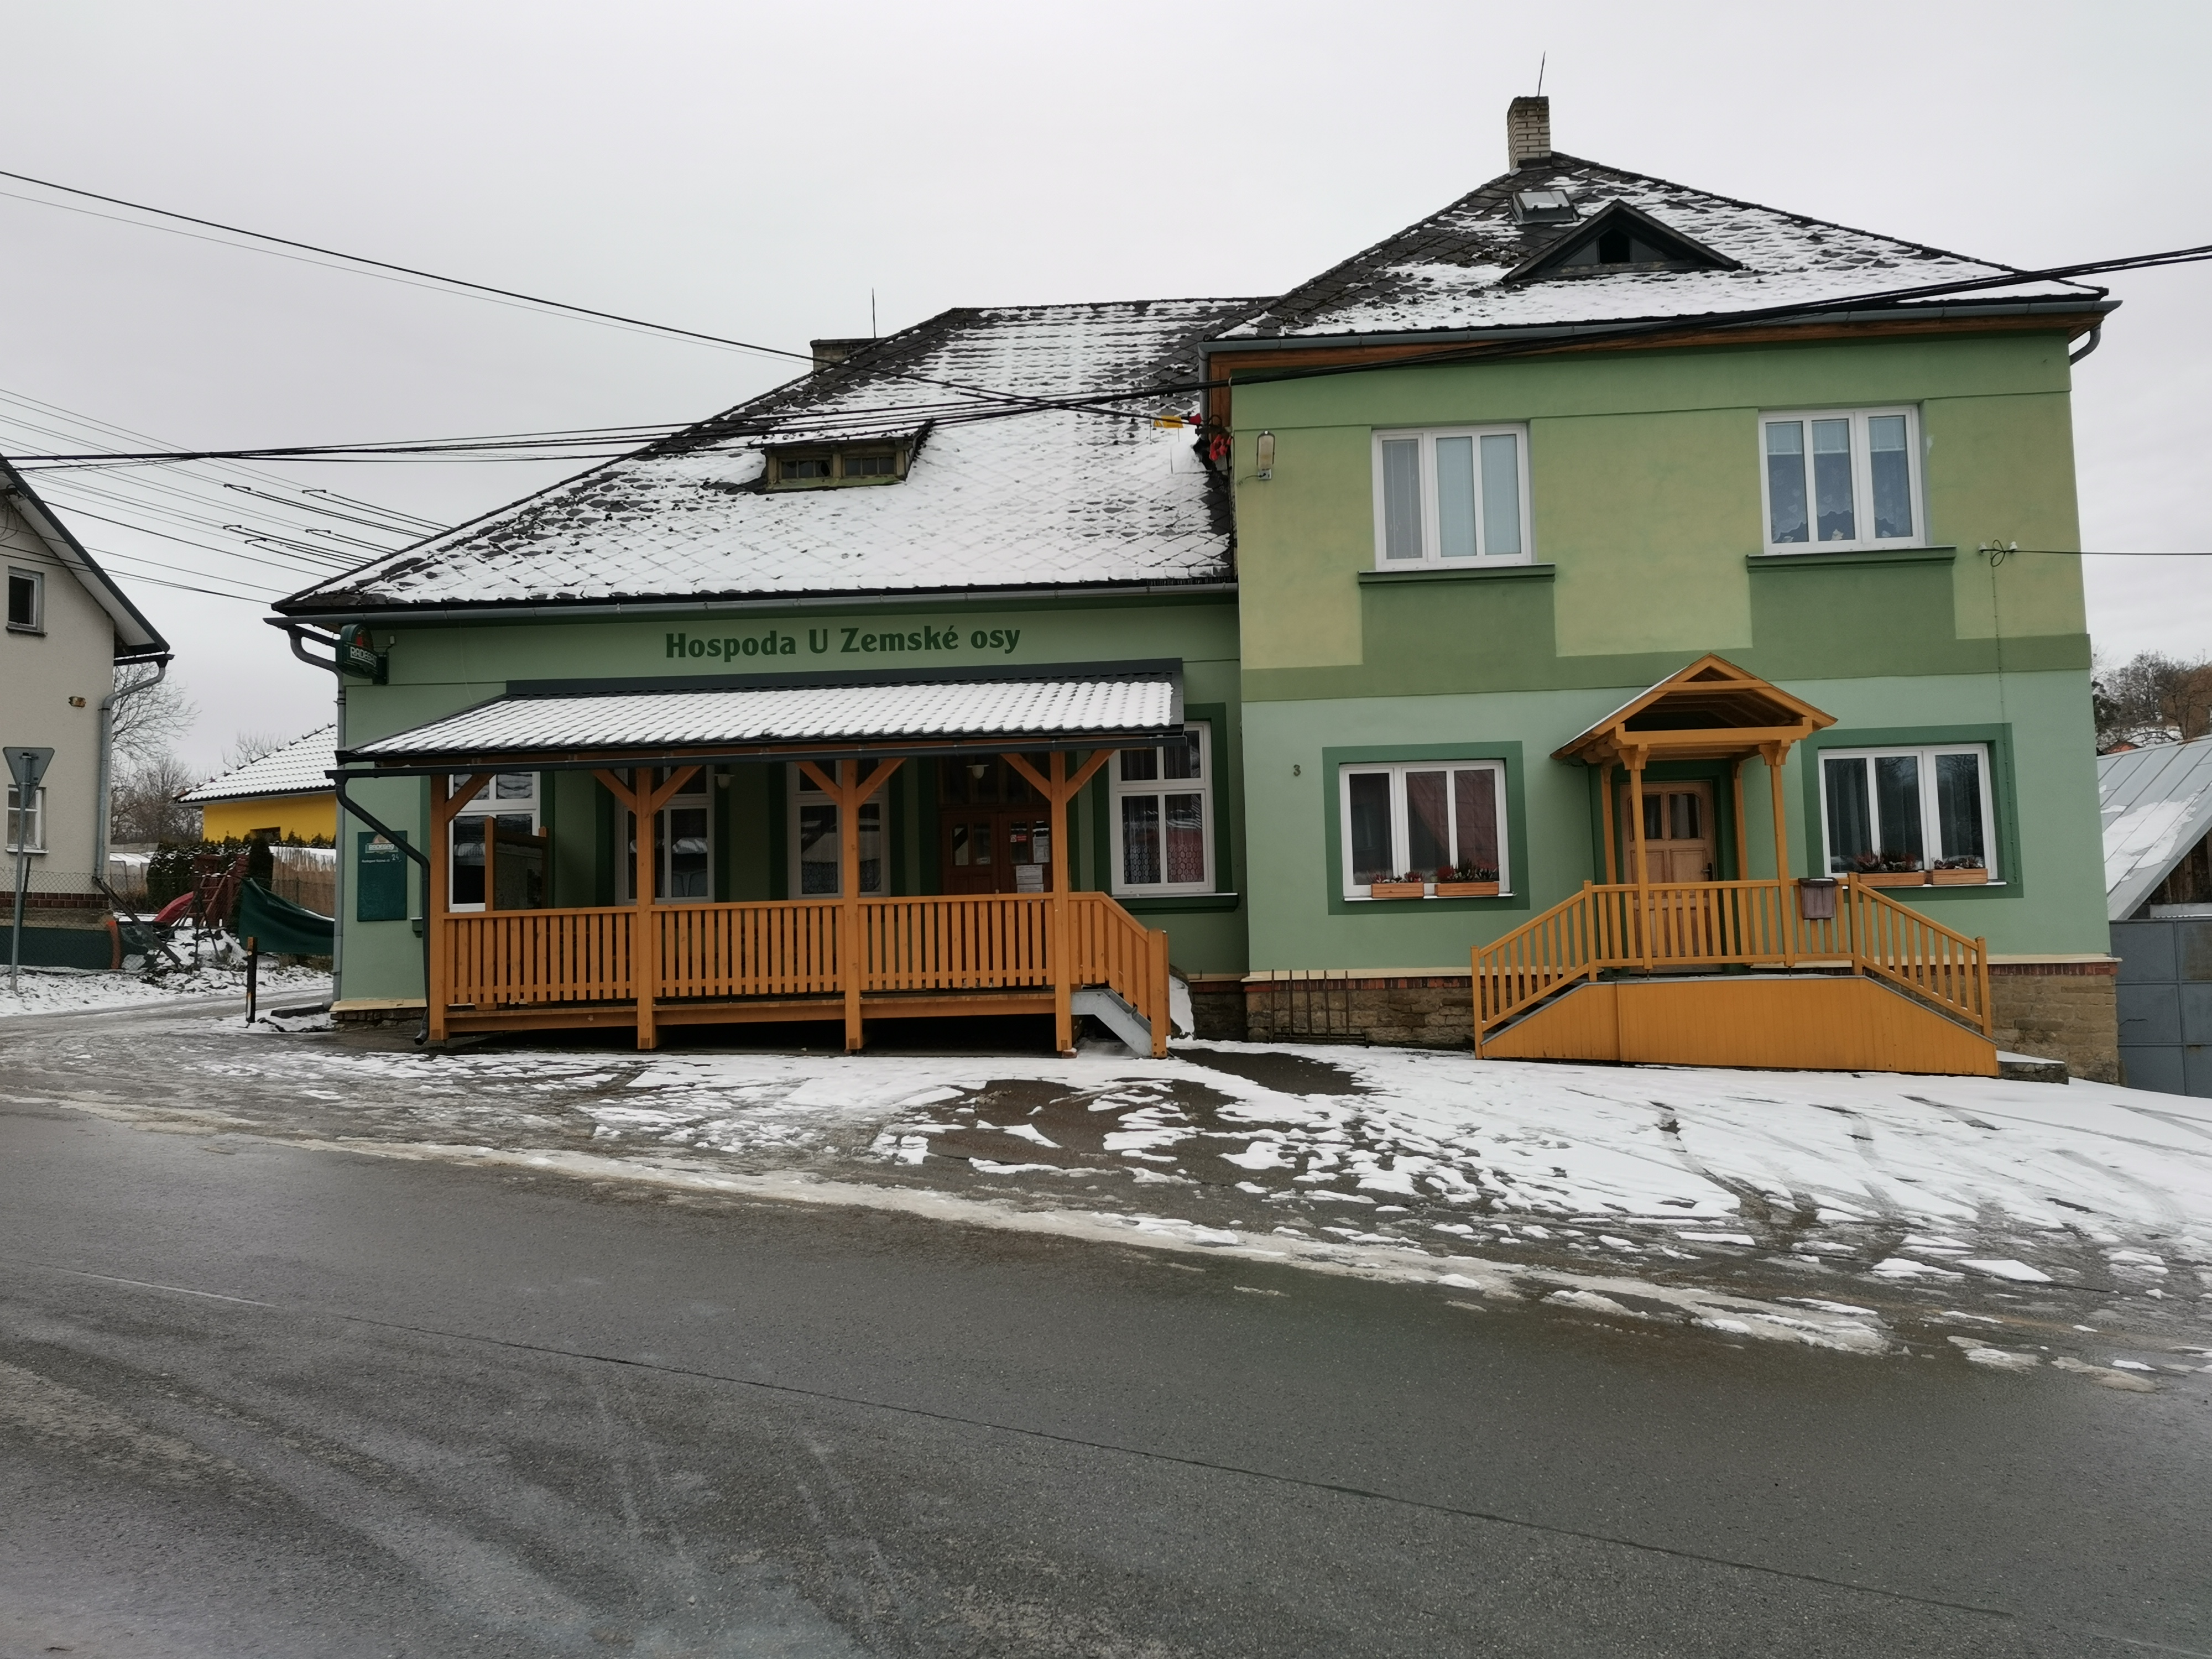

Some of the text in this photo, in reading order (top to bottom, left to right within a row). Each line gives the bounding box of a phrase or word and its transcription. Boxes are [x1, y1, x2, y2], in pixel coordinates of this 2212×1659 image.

[666, 625, 1021, 662] Hospoda U Zemské osy
[1293, 764, 1301, 777] 3
